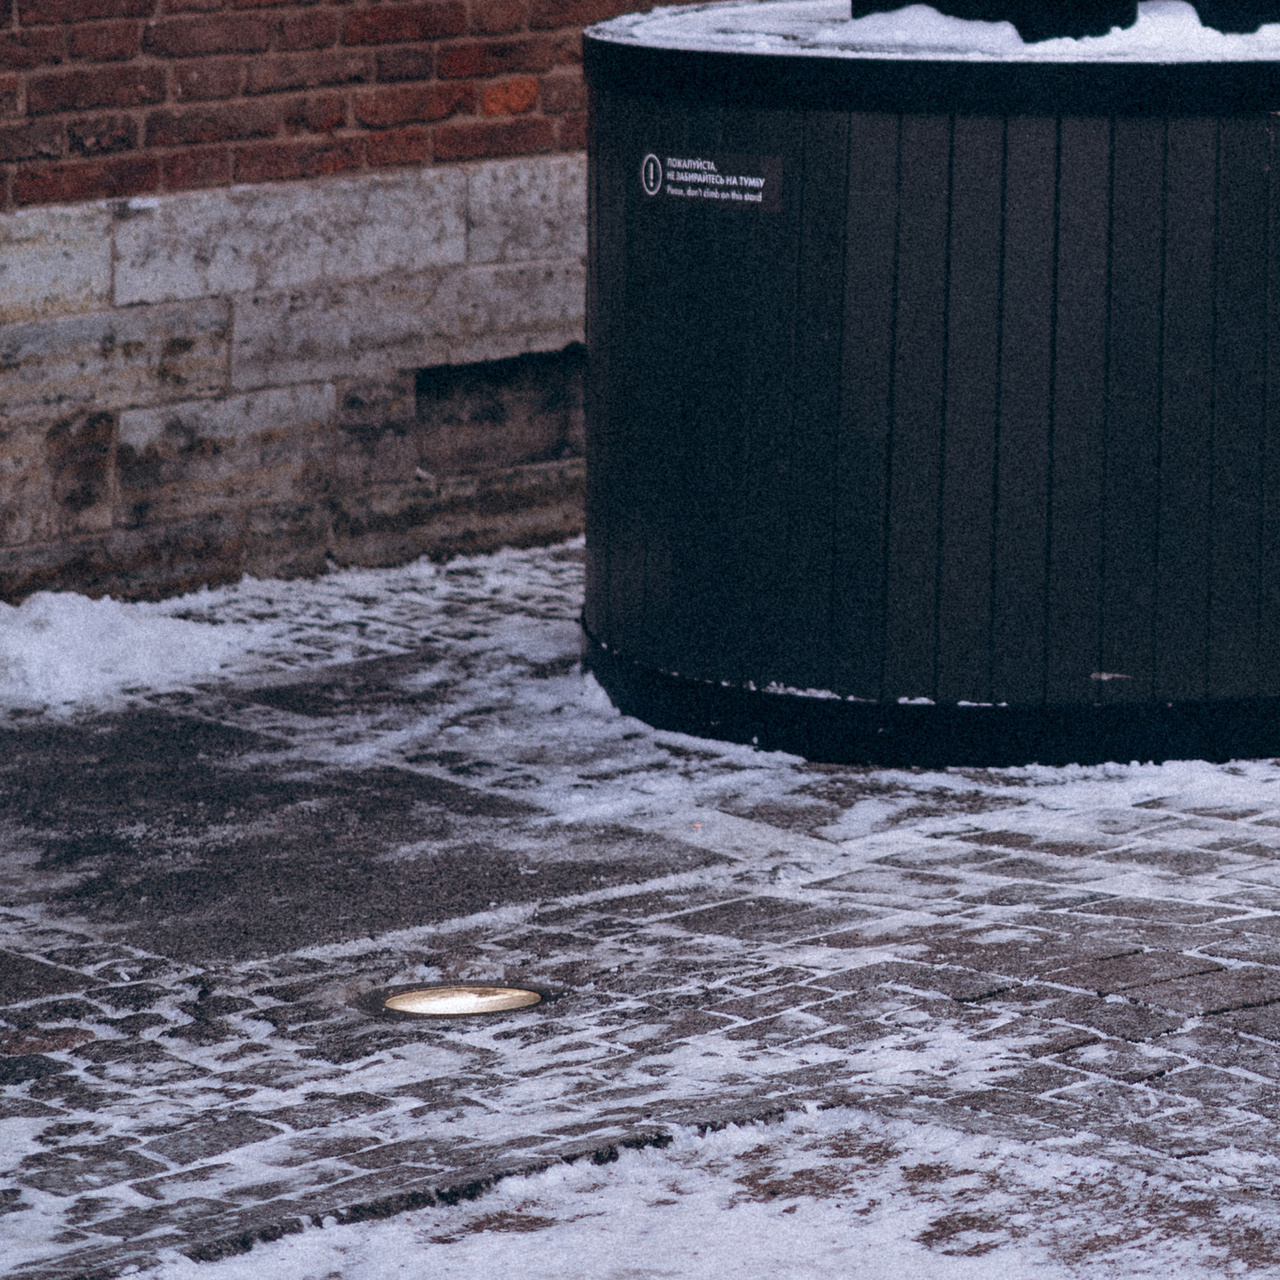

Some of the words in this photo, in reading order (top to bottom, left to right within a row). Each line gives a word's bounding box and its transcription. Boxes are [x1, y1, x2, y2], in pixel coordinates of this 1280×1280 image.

[667, 158, 717, 171] ПОЖАЛУЙСТА,
[667, 171, 675, 180] НЕ
[676, 172, 725, 184] ЗАБИРАЙТЕСЬ
[726, 175, 738, 186] НА
[739, 176, 765, 188] ТУМБУ
[721, 191, 730, 199] on
[731, 189, 743, 200] this
